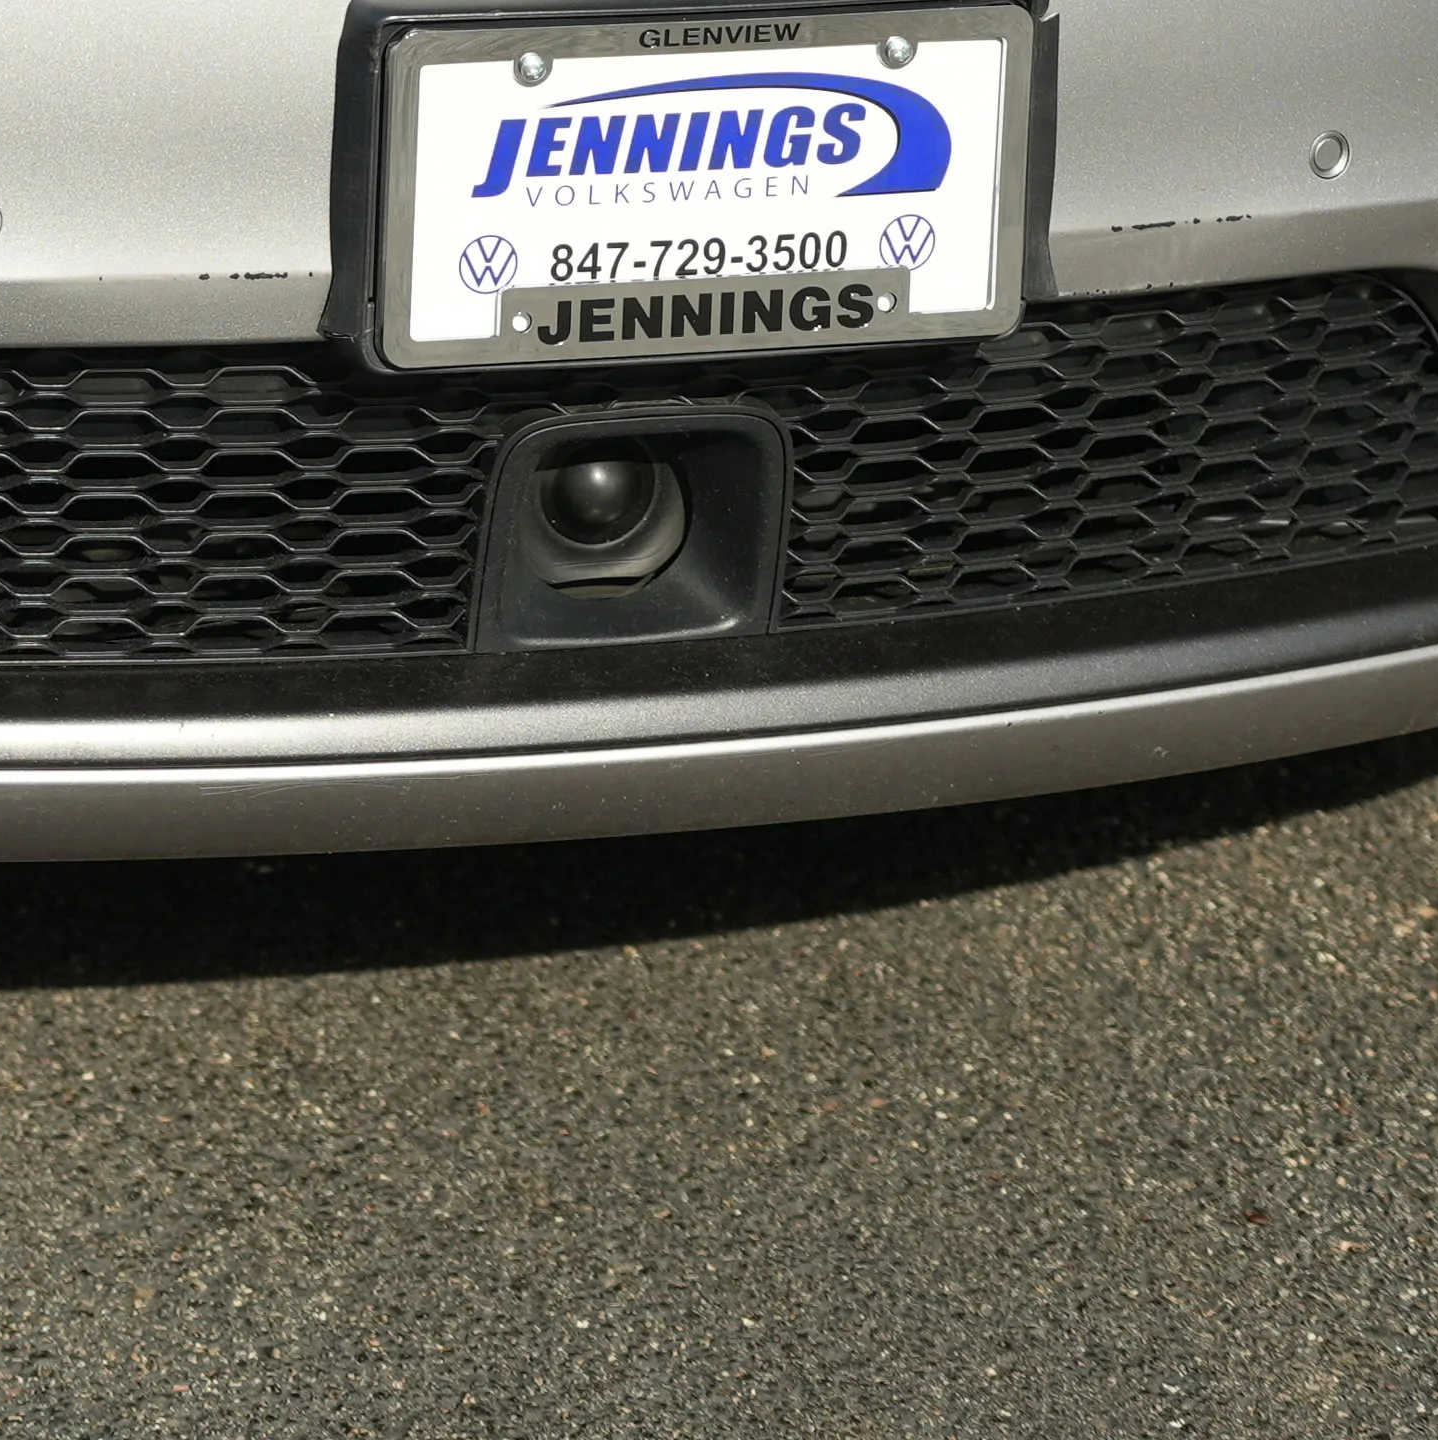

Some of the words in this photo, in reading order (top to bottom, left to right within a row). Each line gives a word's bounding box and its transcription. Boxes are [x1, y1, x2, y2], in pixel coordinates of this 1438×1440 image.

[638, 22, 801, 50] GLENVIEW
[470, 103, 867, 199] JENNINGS
[526, 175, 811, 208] VOLKSWAGEN
[550, 230, 848, 281] 847-729-3500
[537, 283, 875, 347] JENNINGS
